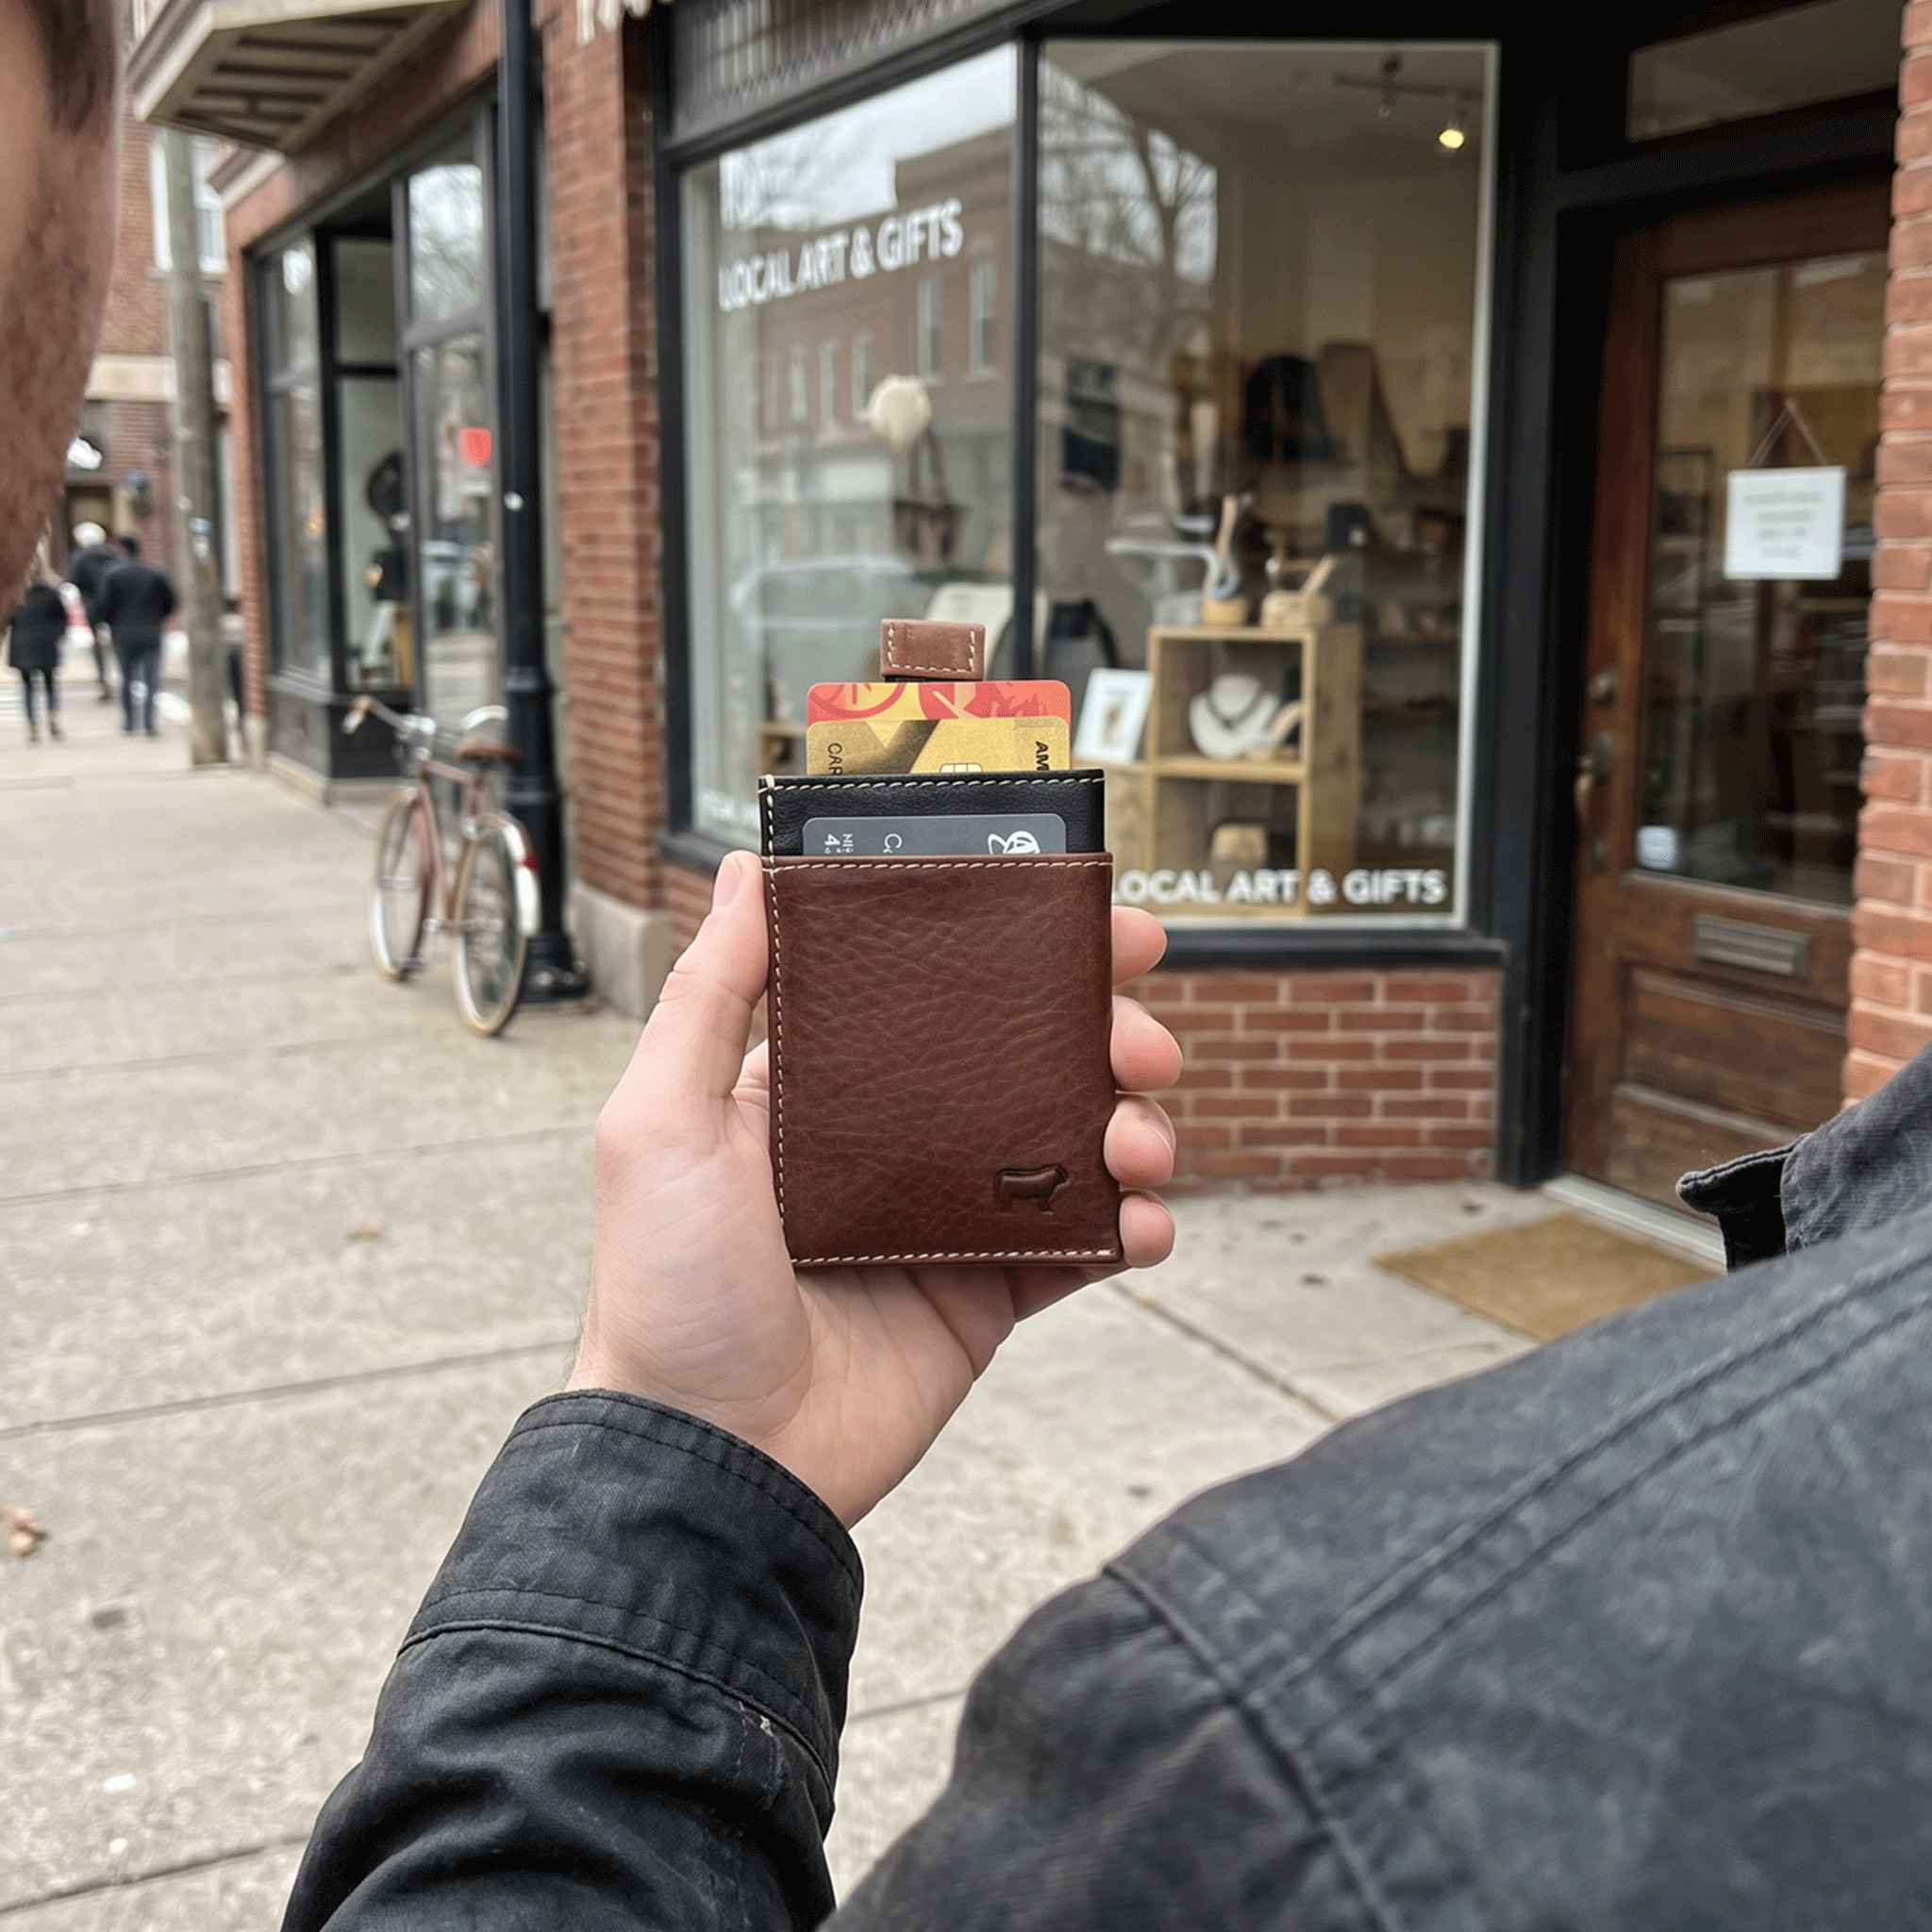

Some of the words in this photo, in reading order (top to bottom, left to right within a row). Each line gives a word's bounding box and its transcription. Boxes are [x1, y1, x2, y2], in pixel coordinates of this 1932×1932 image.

[850, 224, 874, 279] &
[875, 196, 963, 272] GIFTS
[1225, 868, 1301, 905] ART
[1305, 868, 1336, 905] &
[1342, 868, 1446, 906] GIFTS
